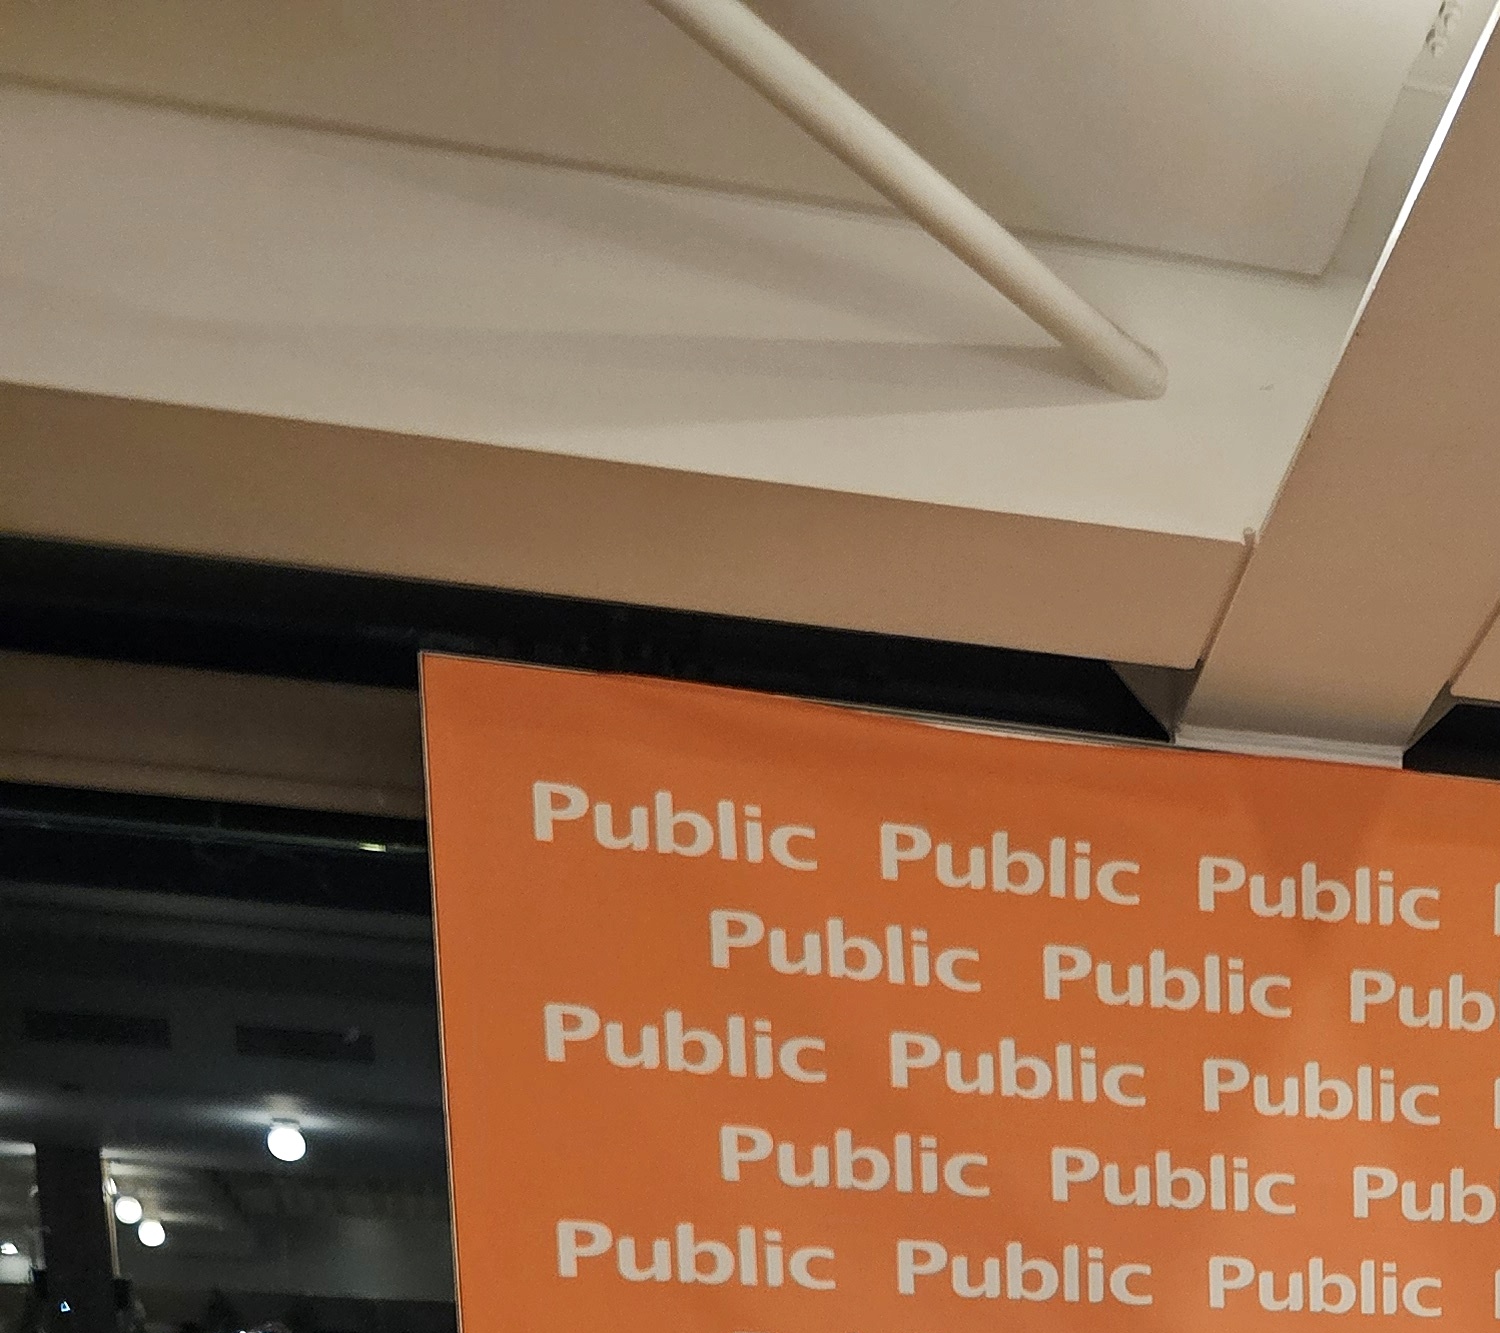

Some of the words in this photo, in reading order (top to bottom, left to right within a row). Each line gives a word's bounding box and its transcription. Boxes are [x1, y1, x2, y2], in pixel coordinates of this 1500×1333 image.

[533, 781, 816, 869] Public
[881, 823, 1139, 904] Public
[1199, 857, 1439, 928] Public
[711, 910, 980, 991] Public
[1044, 945, 1290, 1016] Public
[545, 1004, 826, 1081] Public
[891, 1032, 1145, 1105] Public
[1204, 1059, 1440, 1125] Public
[720, 1126, 989, 1196] Public
[1052, 1148, 1295, 1215] Public
[557, 1221, 835, 1289] Public
[898, 1240, 1152, 1305] Public
[1209, 1256, 1441, 1317] Public
